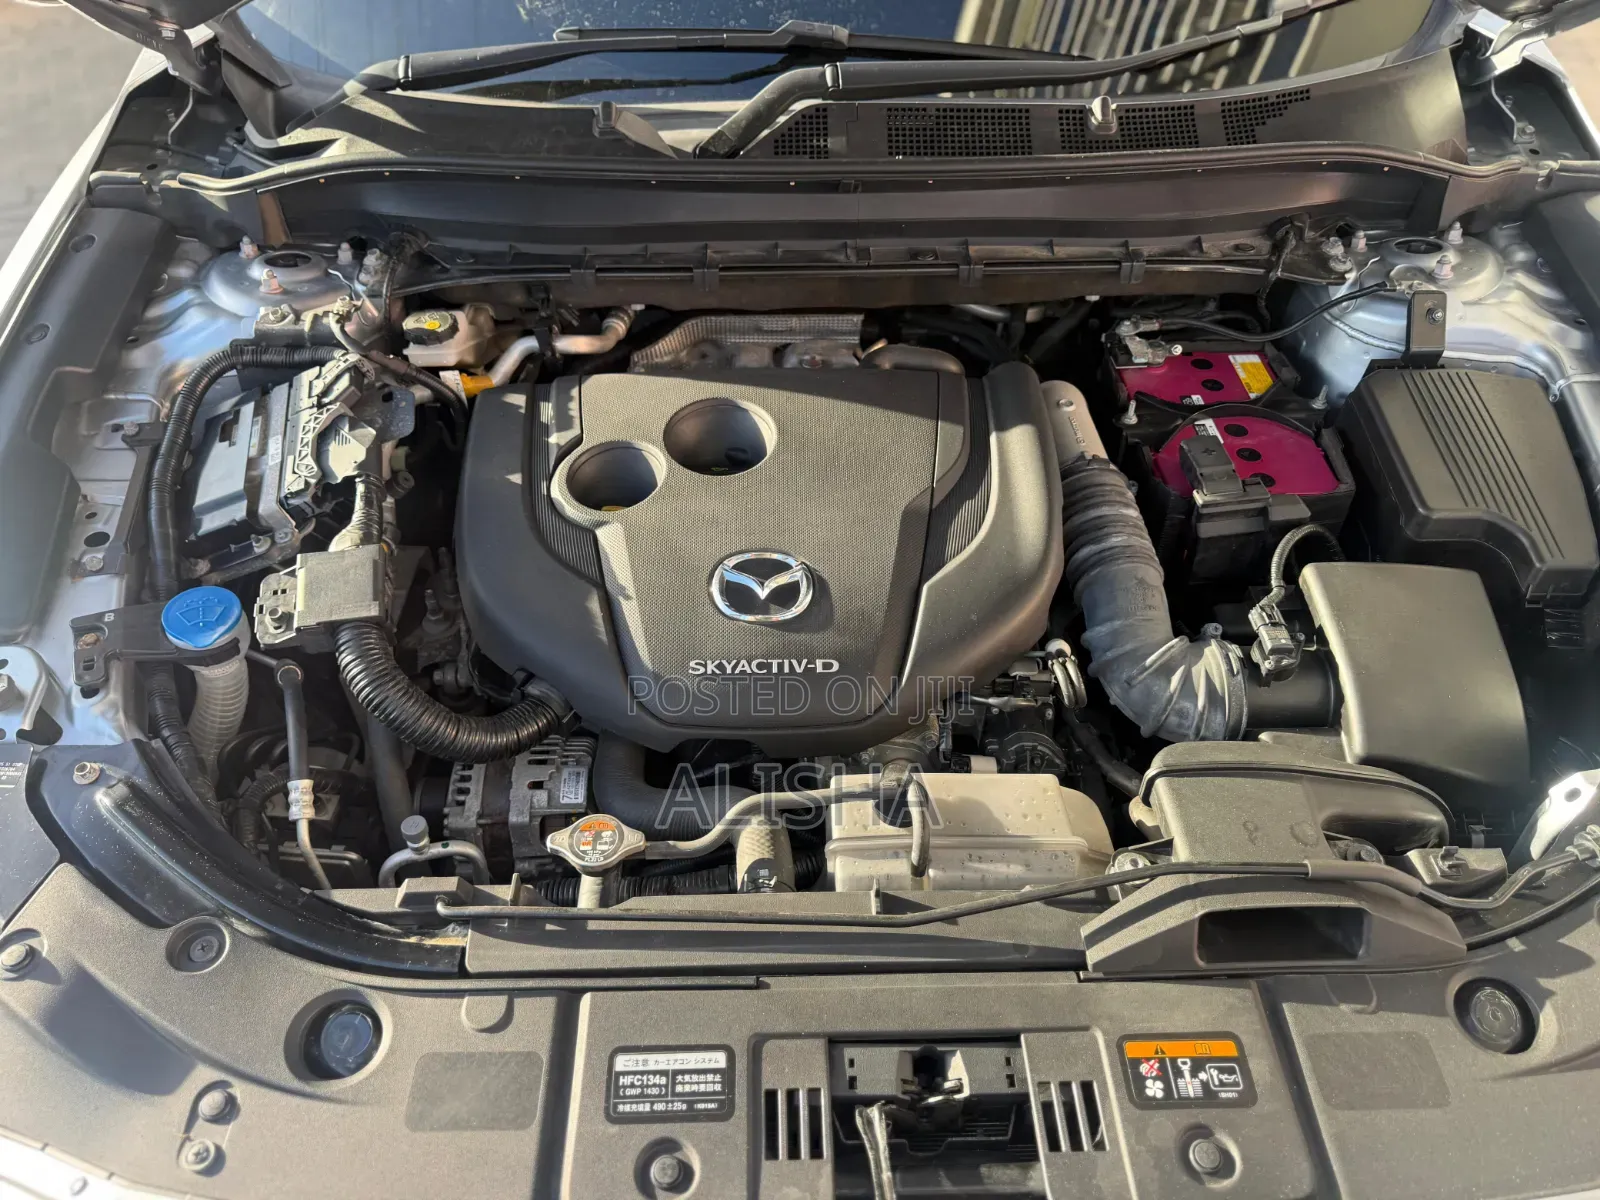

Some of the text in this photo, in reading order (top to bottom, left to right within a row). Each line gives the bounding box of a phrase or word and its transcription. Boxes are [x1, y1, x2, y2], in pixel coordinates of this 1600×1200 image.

[688, 658, 840, 675] SKYACTIV-D
[623, 1059, 649, 1068] ご注意
[619, 1074, 667, 1086] HFC134a
